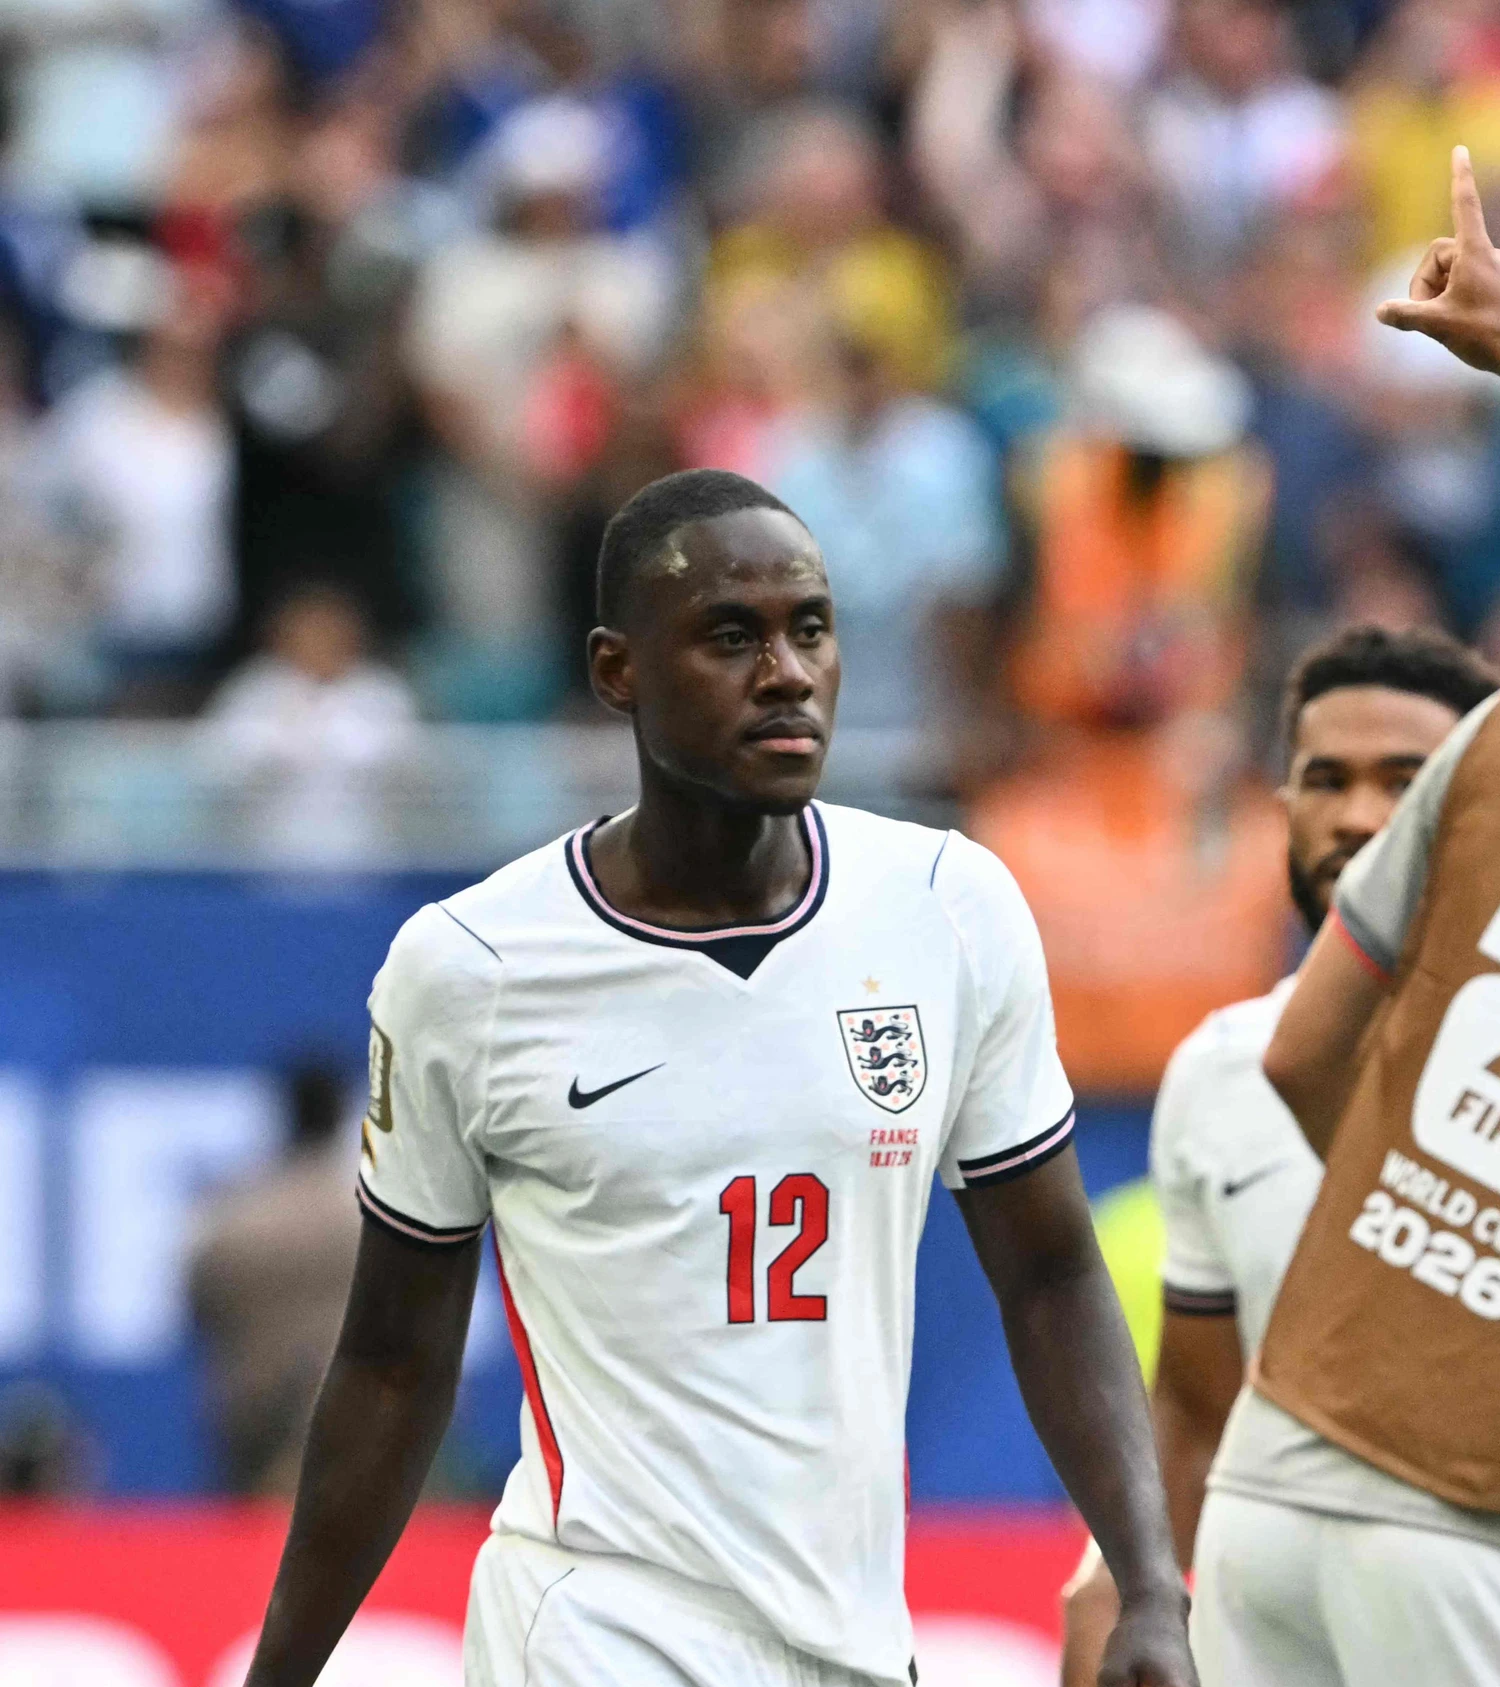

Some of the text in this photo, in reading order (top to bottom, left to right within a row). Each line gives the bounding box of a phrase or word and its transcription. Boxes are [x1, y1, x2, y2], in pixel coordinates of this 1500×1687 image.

[870, 1129, 918, 1145] FRANCE
[1380, 1149, 1477, 1227] WORLD
[720, 1173, 829, 1323] 12
